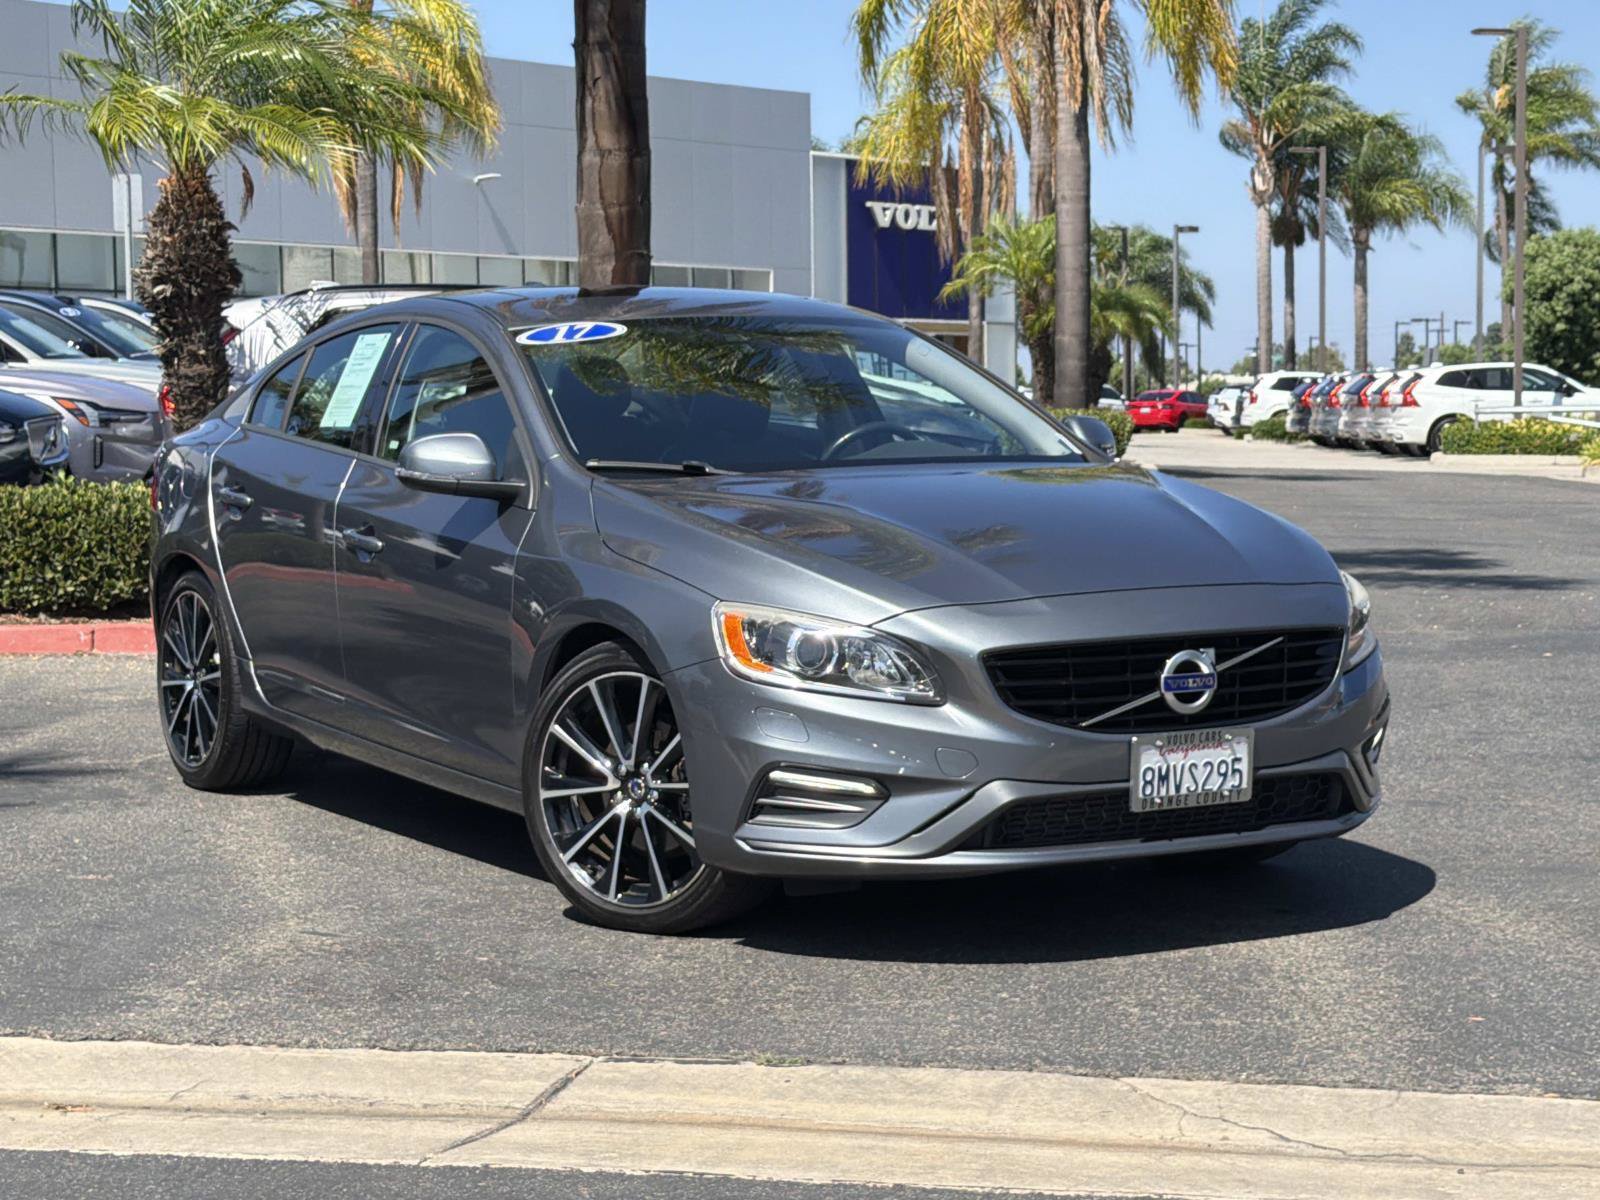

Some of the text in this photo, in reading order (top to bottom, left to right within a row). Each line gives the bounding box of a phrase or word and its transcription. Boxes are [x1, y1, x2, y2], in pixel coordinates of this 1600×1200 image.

[865, 201, 938, 231] VOL
[551, 323, 597, 341] 17
[1166, 676, 1213, 689] VOLVO
[1167, 730, 1222, 745] VOLVO CARS
[1141, 757, 1243, 797] 8MVS295
[1141, 789, 1242, 810] ORANGE COUNTY
